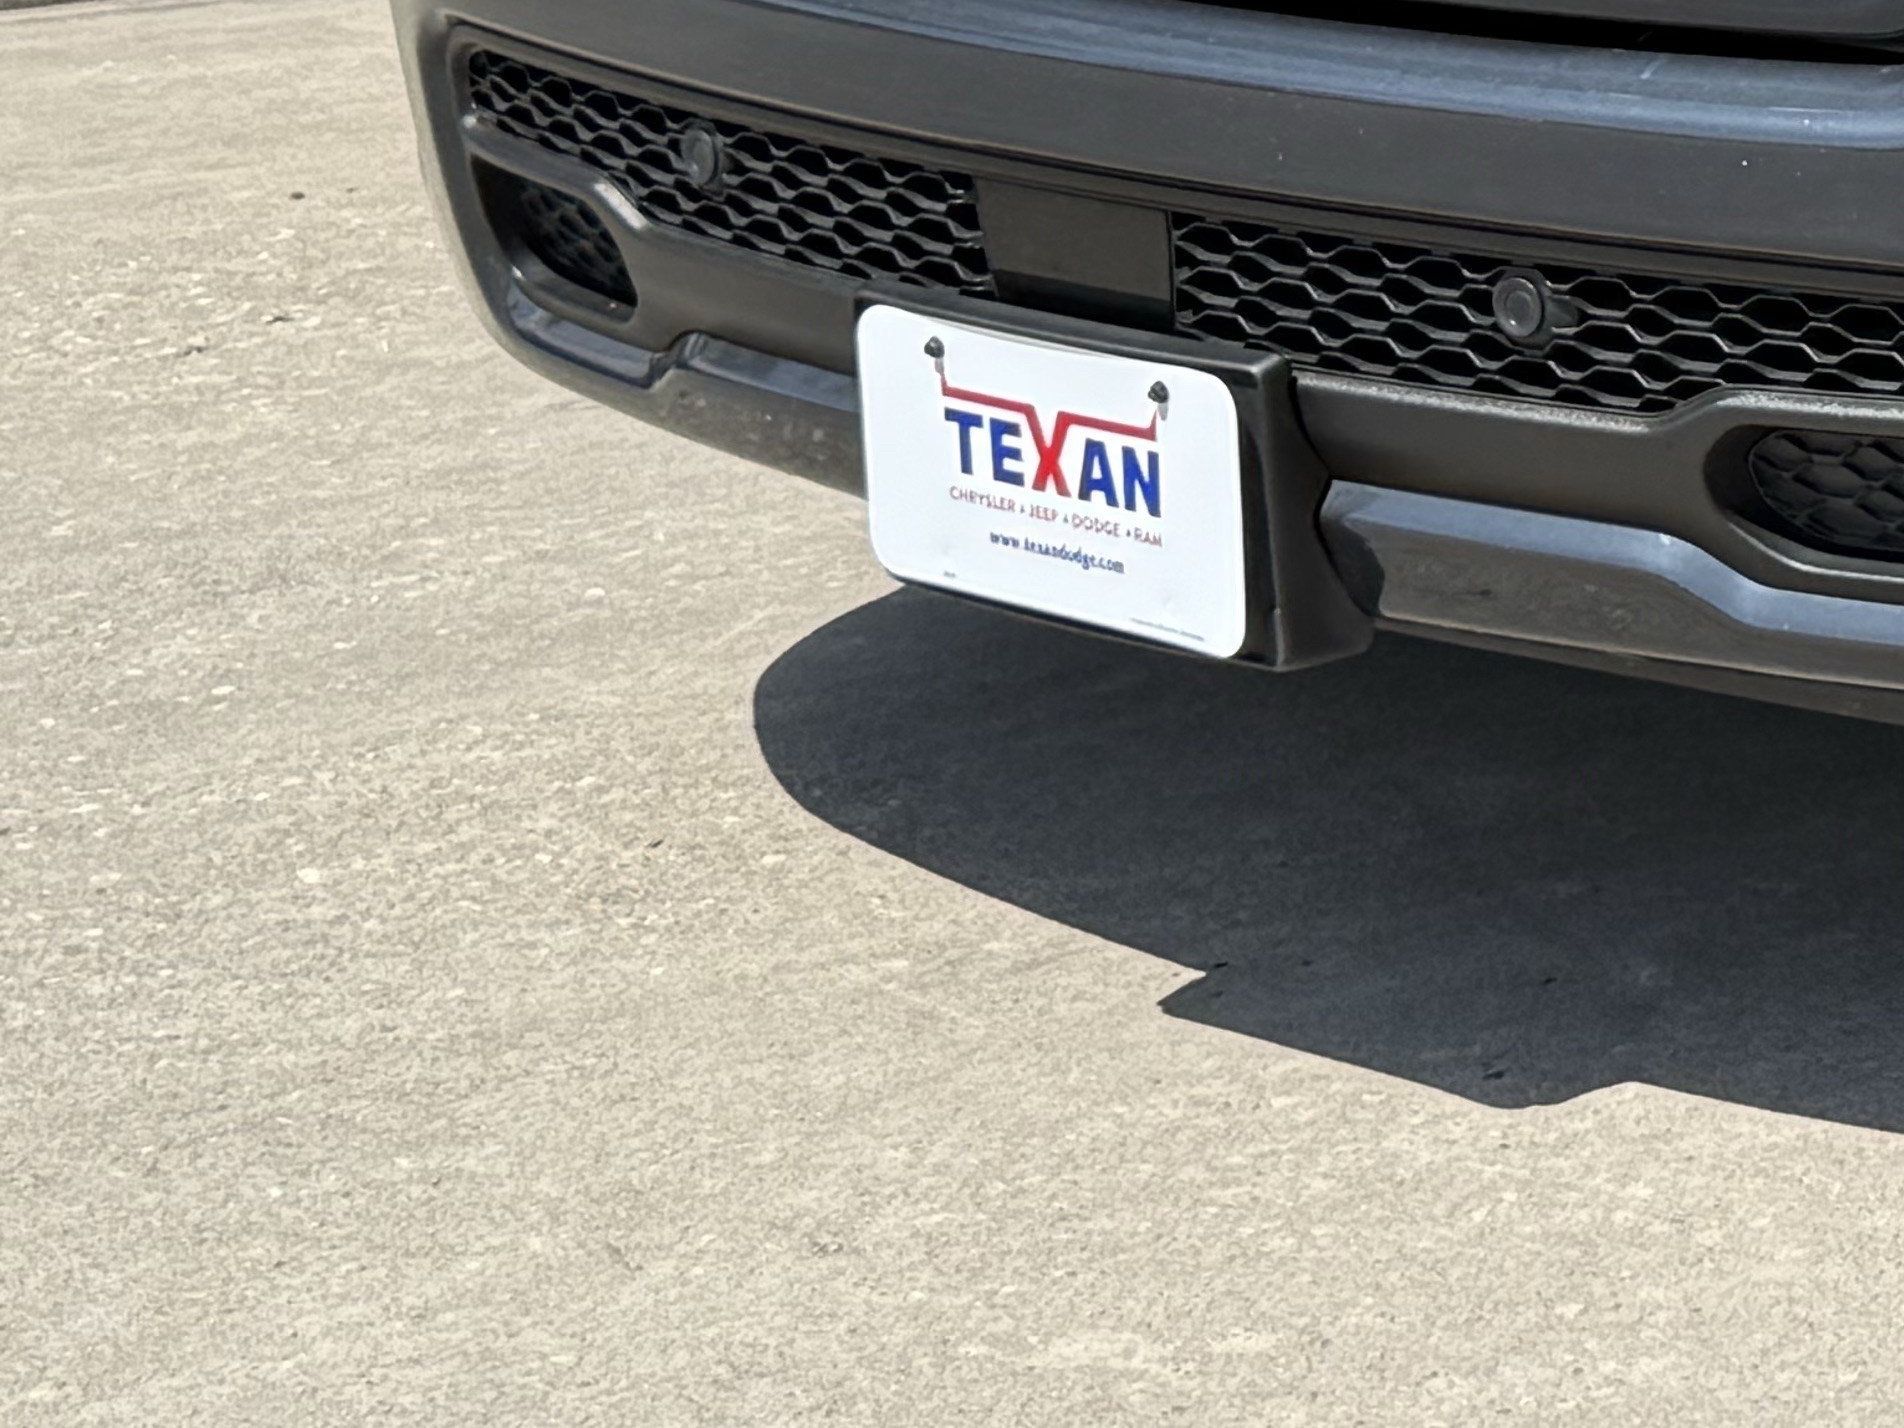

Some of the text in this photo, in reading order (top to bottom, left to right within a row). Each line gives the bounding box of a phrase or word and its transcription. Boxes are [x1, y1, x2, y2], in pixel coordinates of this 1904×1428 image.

[943, 402, 1162, 518] TEXAN
[949, 485, 1163, 548] CHRYSLER JEEP DODGE RAM
